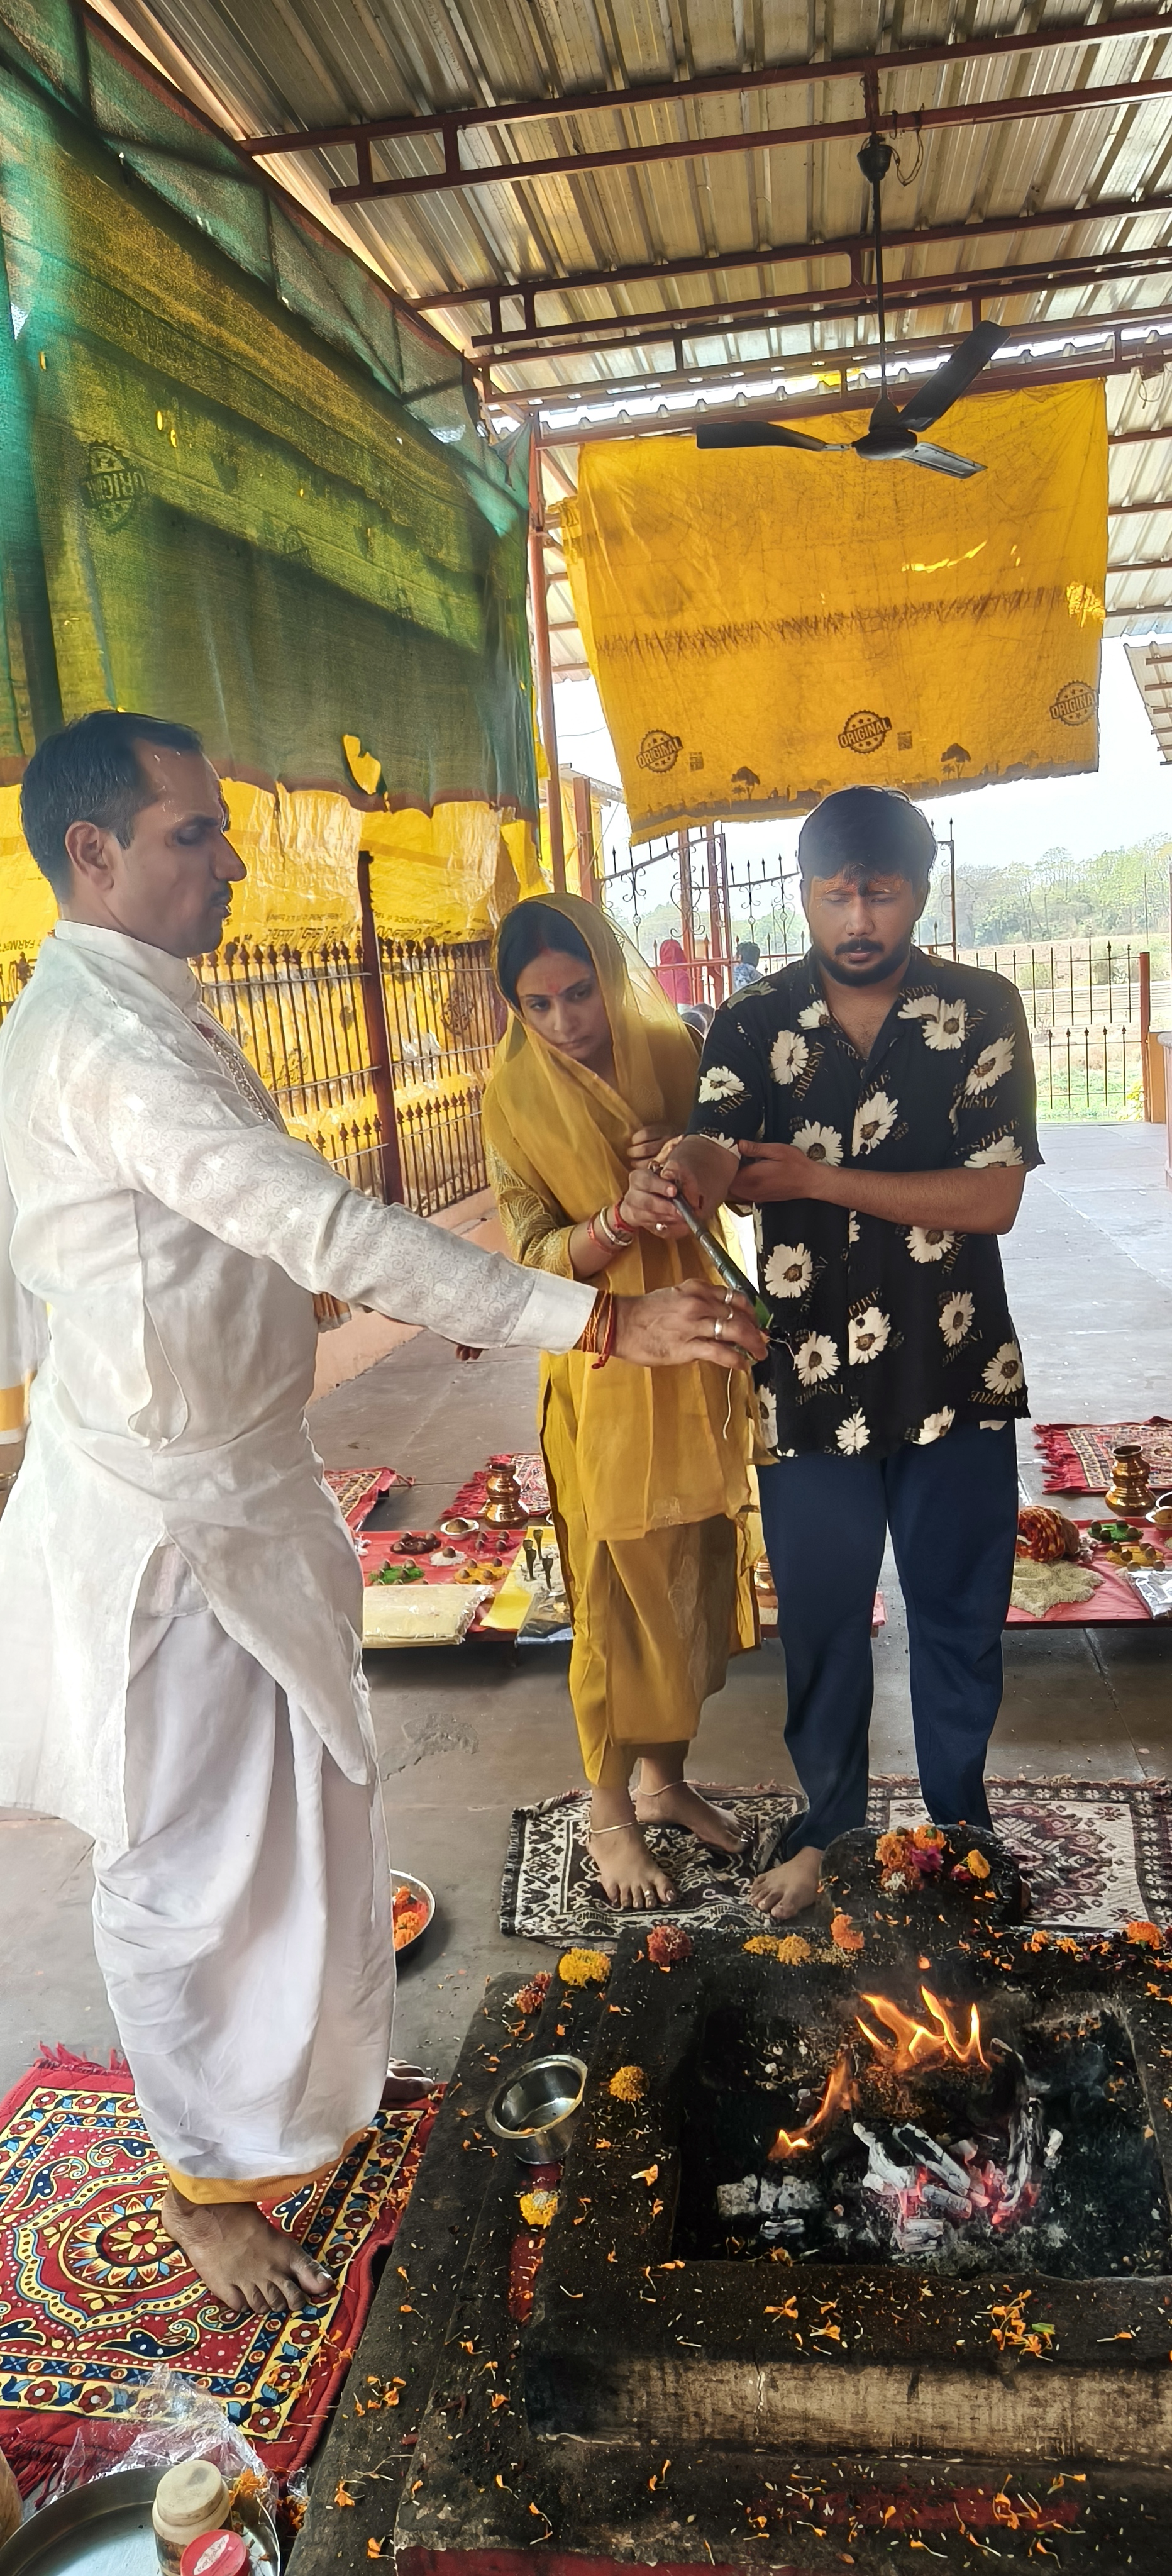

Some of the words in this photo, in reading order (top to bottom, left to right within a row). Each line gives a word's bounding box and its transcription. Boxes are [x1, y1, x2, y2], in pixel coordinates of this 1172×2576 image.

[839, 719, 891, 747] ORIGINAL
[637, 738, 683, 768] ORIGINAL
[792, 1041, 826, 1101] INSPIRE
